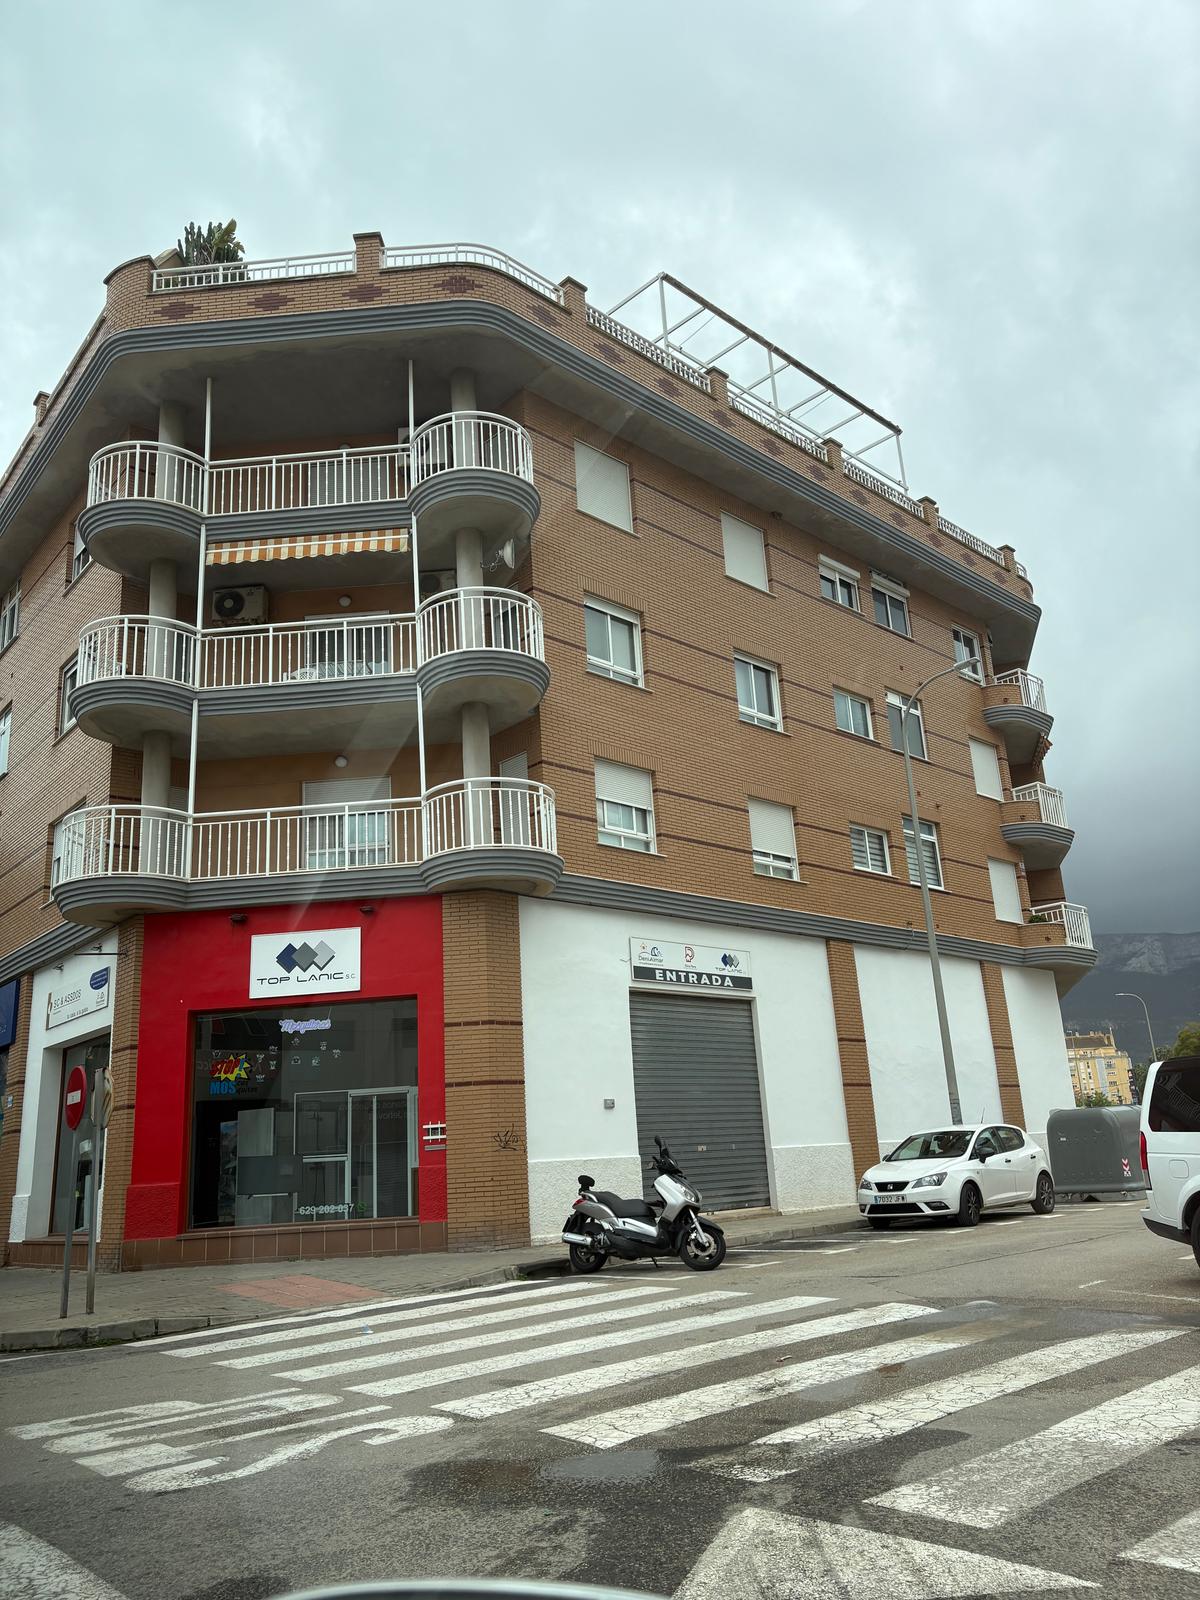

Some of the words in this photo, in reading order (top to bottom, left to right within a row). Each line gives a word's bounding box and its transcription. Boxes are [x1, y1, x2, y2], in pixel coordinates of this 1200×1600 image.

[256, 976, 291, 986] TOP
[296, 971, 344, 983] LANIC
[655, 969, 734, 987] ENTRADA
[208, 1055, 248, 1079] STOP!
[209, 1081, 237, 1095] MOS
[299, 1206, 316, 1215] 629
[319, 1204, 335, 1214] 202
[7, 1387, 456, 1493] STOP
